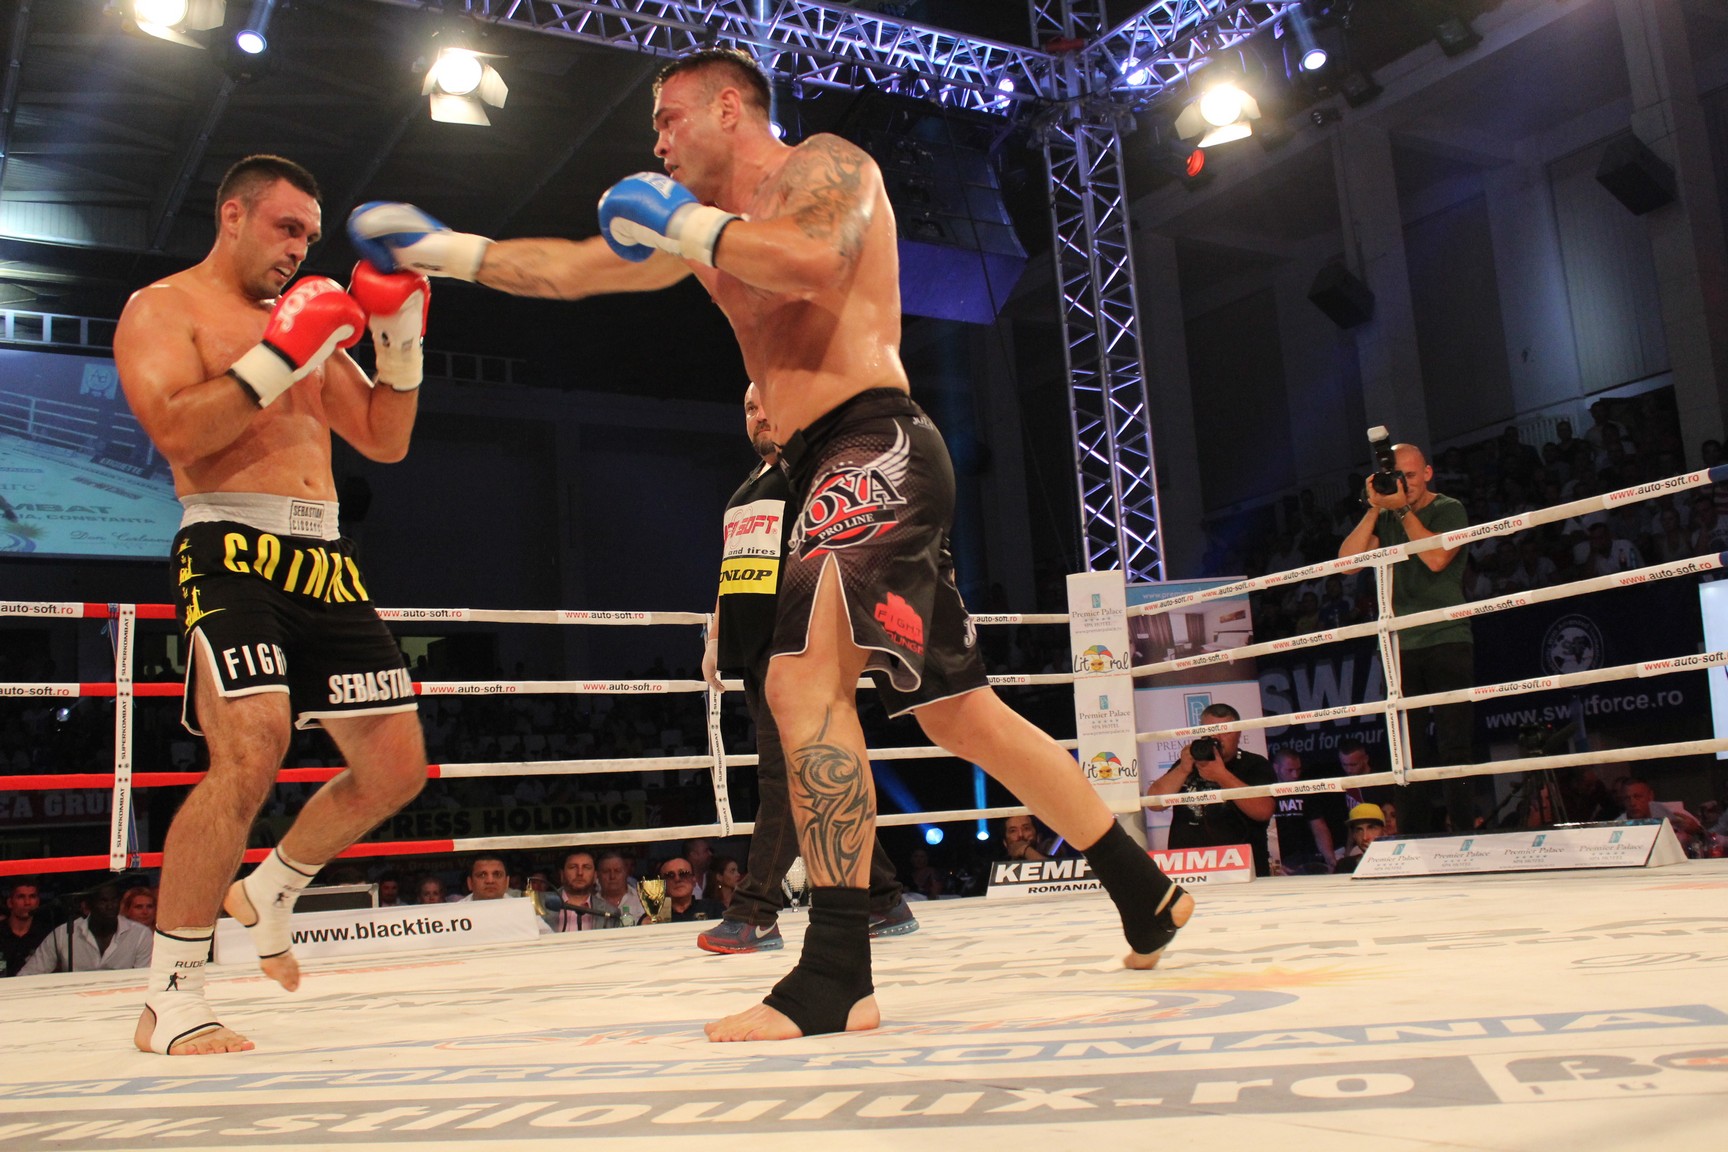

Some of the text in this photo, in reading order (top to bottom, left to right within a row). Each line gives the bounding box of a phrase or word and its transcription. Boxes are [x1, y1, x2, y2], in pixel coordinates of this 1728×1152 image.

[1609, 473, 1700, 501] www.auto-soft.ro
[817, 513, 875, 540] PRO LINE
[1447, 519, 1523, 542] www.auto-soft.ro
[728, 546, 776, 556] and tires
[1333, 547, 1398, 569] www.auto-soft.ro
[1264, 565, 1324, 586] www.auto-soft.ro
[1619, 560, 1712, 586] www.auto-soft.ro
[1200, 581, 1256, 598] www.auto-soft.ro
[1143, 595, 1194, 611] www.auto-soft.ro
[1449, 598, 1526, 619] www.auto-soft.ro
[564, 611, 645, 620] www.auto-soft.ro
[120, 617, 130, 676] SUPERKOMBAT
[1272, 633, 1333, 650] www.auto-soft.ro
[1175, 652, 1229, 668] www.auto-soft.ro
[429, 684, 516, 694] www.auto-soft.ro
[582, 682, 662, 692] www.auto-soft.ro
[1473, 679, 1552, 695] www.auto-soft.ro
[1294, 705, 1357, 720] www.auto-soft.ro
[1486, 688, 1684, 729] www.swtforce.ro
[120, 699, 128, 760] SUPERKOMBAT
[1174, 725, 1228, 736] www.auto-soft.ro
[1319, 731, 1341, 750] for
[1274, 782, 1336, 794] www.auto-soft.ro
[1164, 793, 1217, 805] www.auto-soft.ro
[116, 787, 125, 848] SUPERKOMBAT
[484, 802, 632, 835] HOLDING
[1155, 847, 1245, 872] MMA
[291, 915, 473, 944] www.blacktie.ro
[237, 1057, 768, 1089] FORCE
[802, 1010, 1700, 1068] ROMANIA
